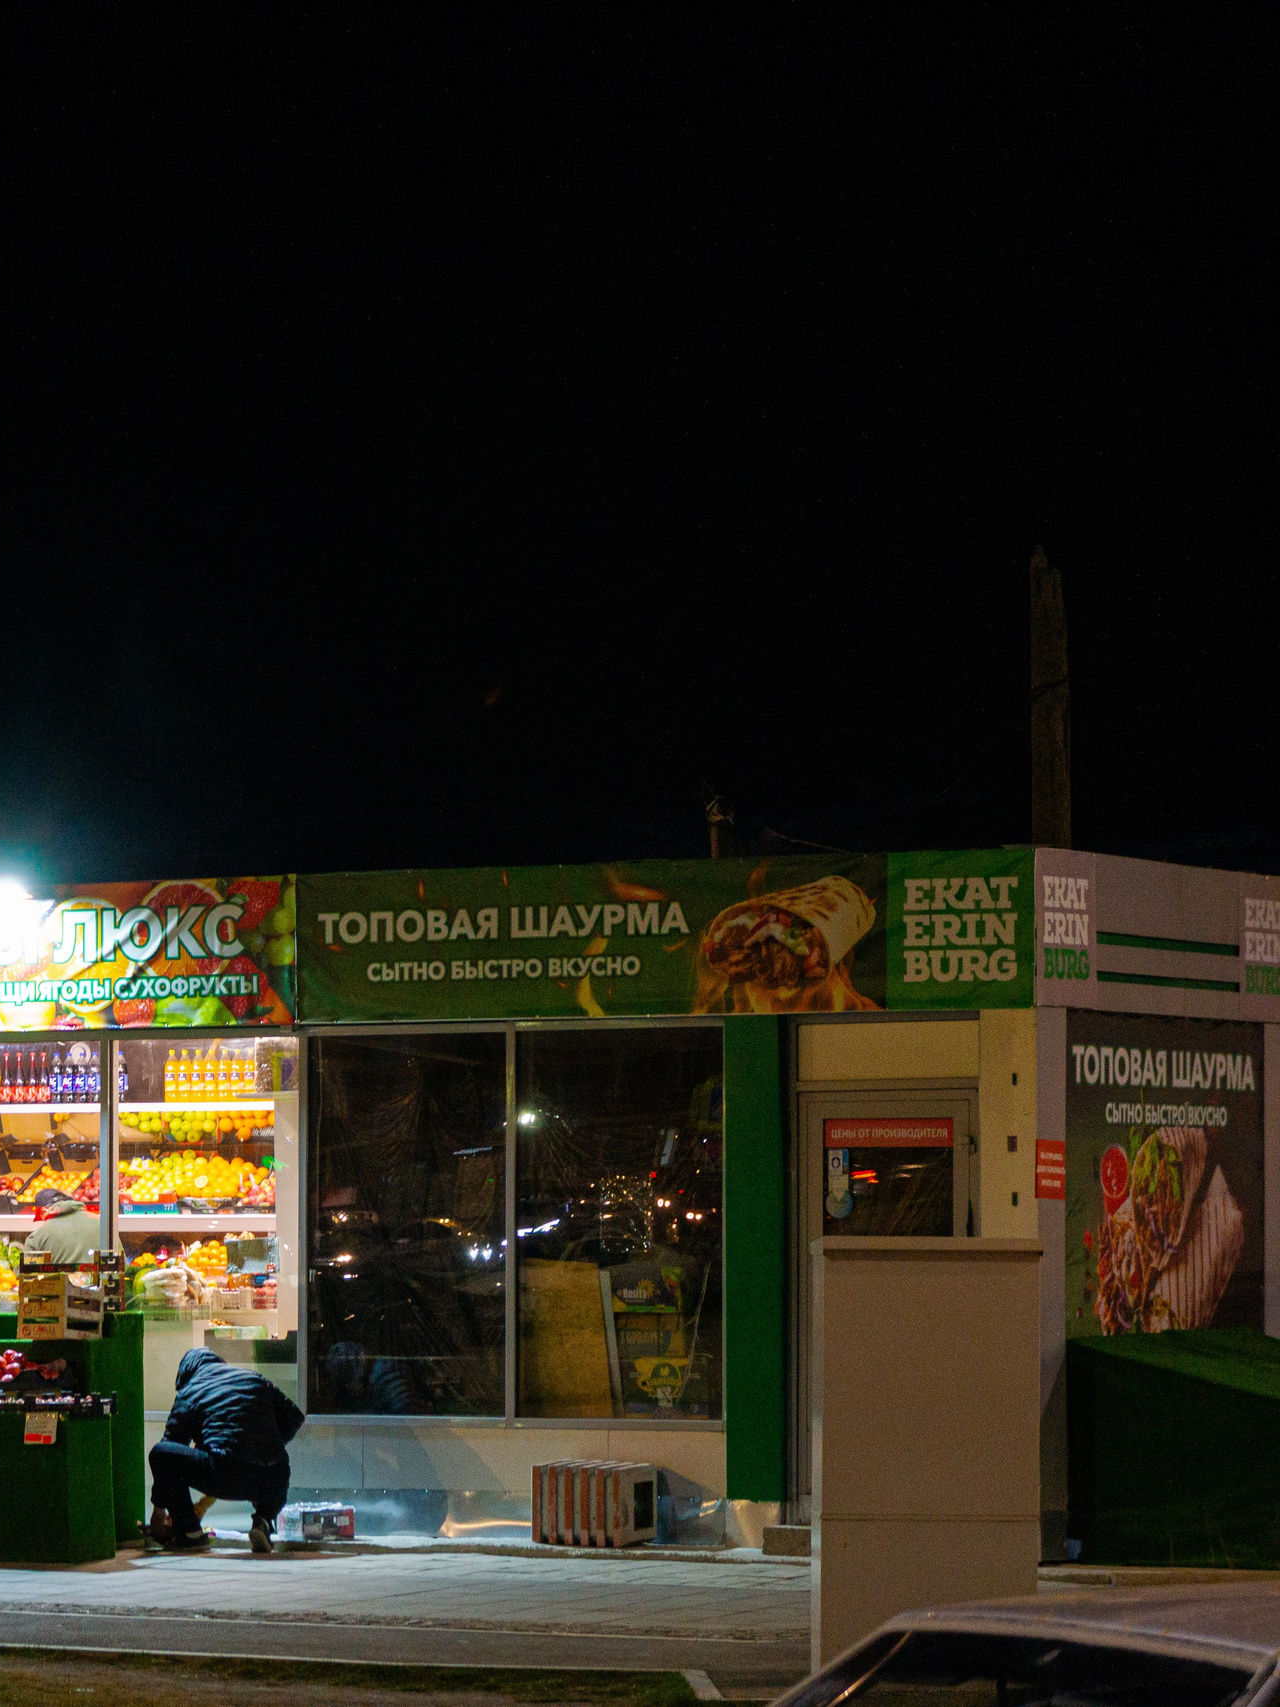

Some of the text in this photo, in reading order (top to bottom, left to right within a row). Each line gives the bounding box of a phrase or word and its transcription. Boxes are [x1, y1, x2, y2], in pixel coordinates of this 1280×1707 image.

[903, 877, 1018, 910] EKAT
[1043, 875, 1089, 910] EKAT
[53, 903, 245, 964] ЛЮКС
[319, 902, 690, 944] ТОПОВАЯ ШАУРМА
[903, 913, 1018, 946] ERIN
[1043, 911, 1089, 946] ERIN
[367, 955, 640, 982] СЫТНО БЫСТРО ВКУСНО
[903, 949, 1018, 982] BURG
[1043, 948, 1090, 981] BURG
[38, 979, 111, 1004] ЯГОДЫ
[115, 974, 258, 999] СУХОФРУКТЫ
[1072, 1045, 1255, 1091] ТОПОВАЯ ШАУРМА
[1105, 1102, 1227, 1127] СЫТНО БЫСТРО ВКУСНО
[831, 1127, 948, 1140] ЦЕНЫ ОТ ПРОИЗВОДИТЕЛЯ
